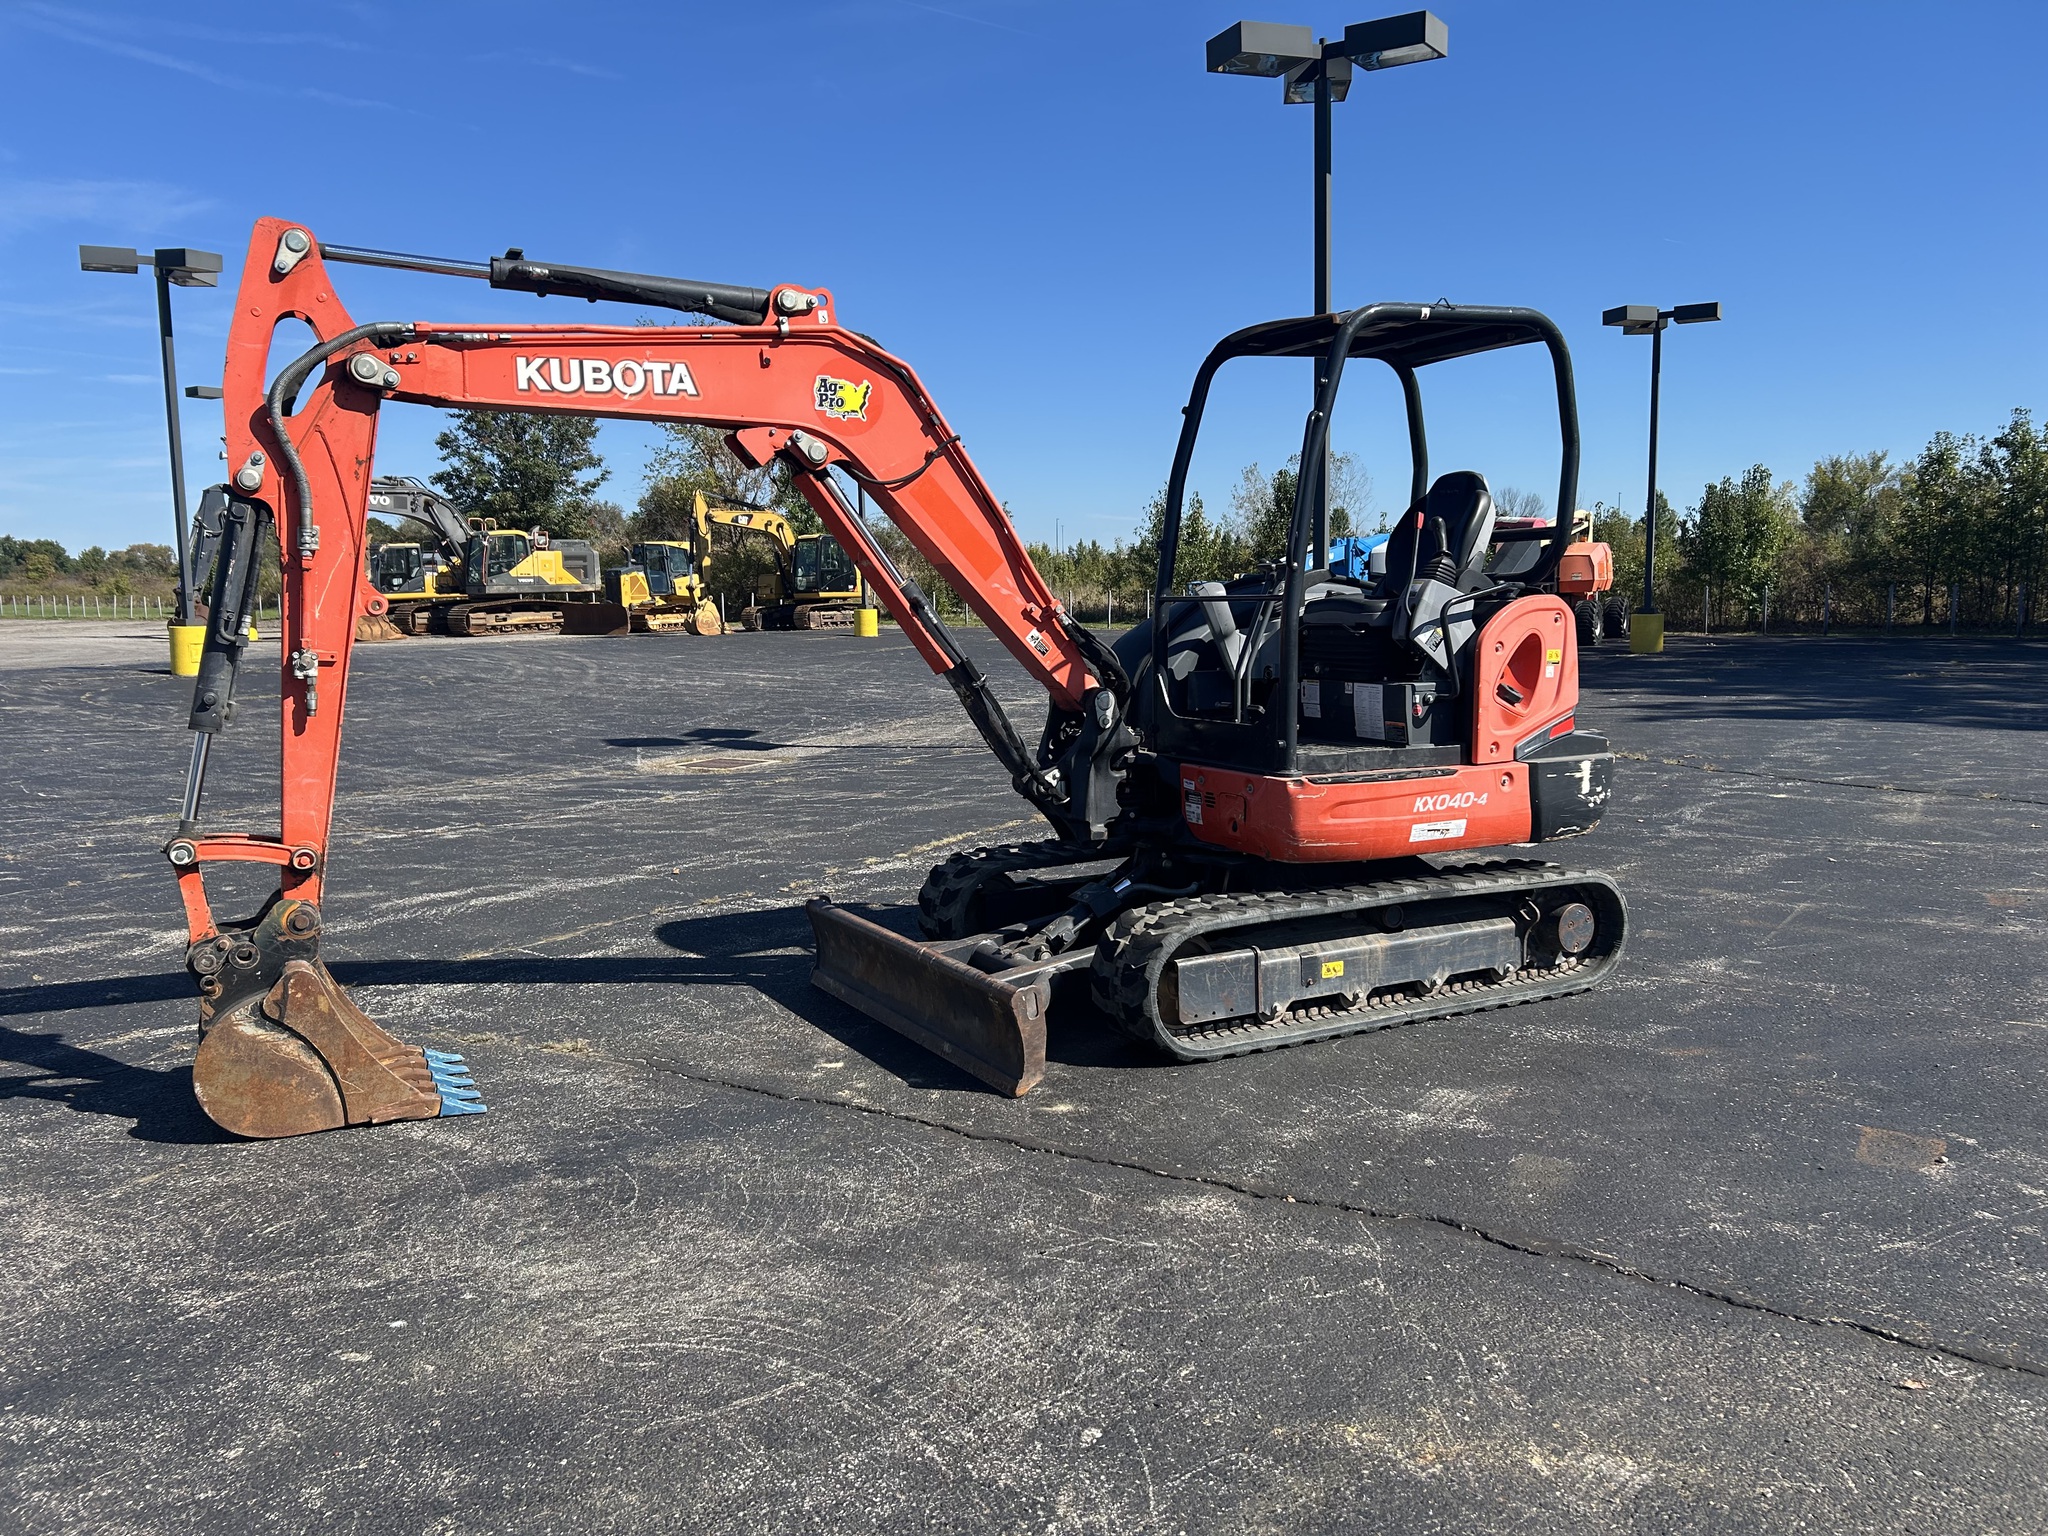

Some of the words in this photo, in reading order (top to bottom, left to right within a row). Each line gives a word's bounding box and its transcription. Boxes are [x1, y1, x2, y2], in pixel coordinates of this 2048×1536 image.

[515, 356, 699, 397] KUBOTA
[817, 378, 844, 397] Ag-
[817, 392, 845, 408] Pro
[738, 515, 749, 525] CAT
[1412, 791, 1489, 813] KX040-4
